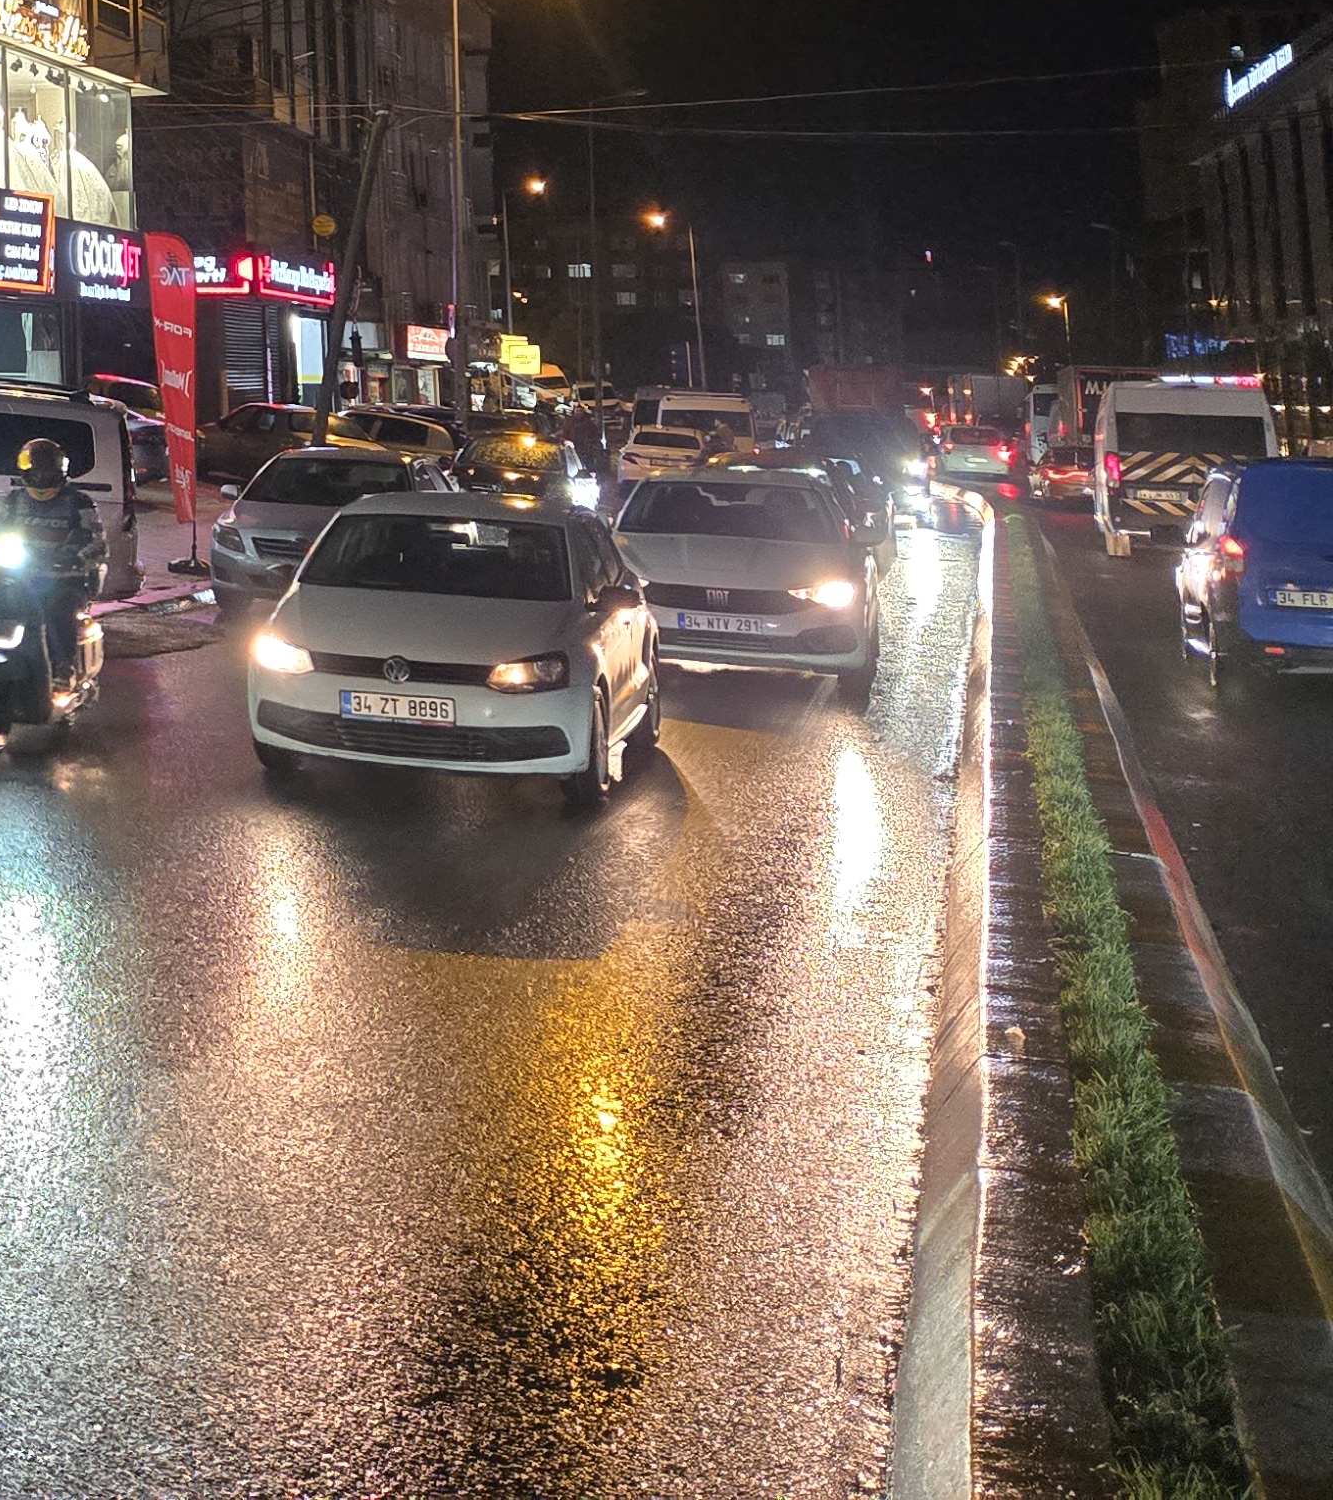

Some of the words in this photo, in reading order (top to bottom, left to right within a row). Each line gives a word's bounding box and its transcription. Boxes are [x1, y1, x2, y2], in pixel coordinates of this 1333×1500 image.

[706, 589, 730, 606] FIAT
[1279, 592, 1295, 605] 34
[1302, 593, 1328, 606] FLR
[685, 616, 700, 628] 34
[707, 617, 730, 630] NTV
[736, 619, 759, 632] 291
[353, 695, 372, 713] 34
[380, 697, 400, 715] ZT
[408, 699, 449, 719] 8896
